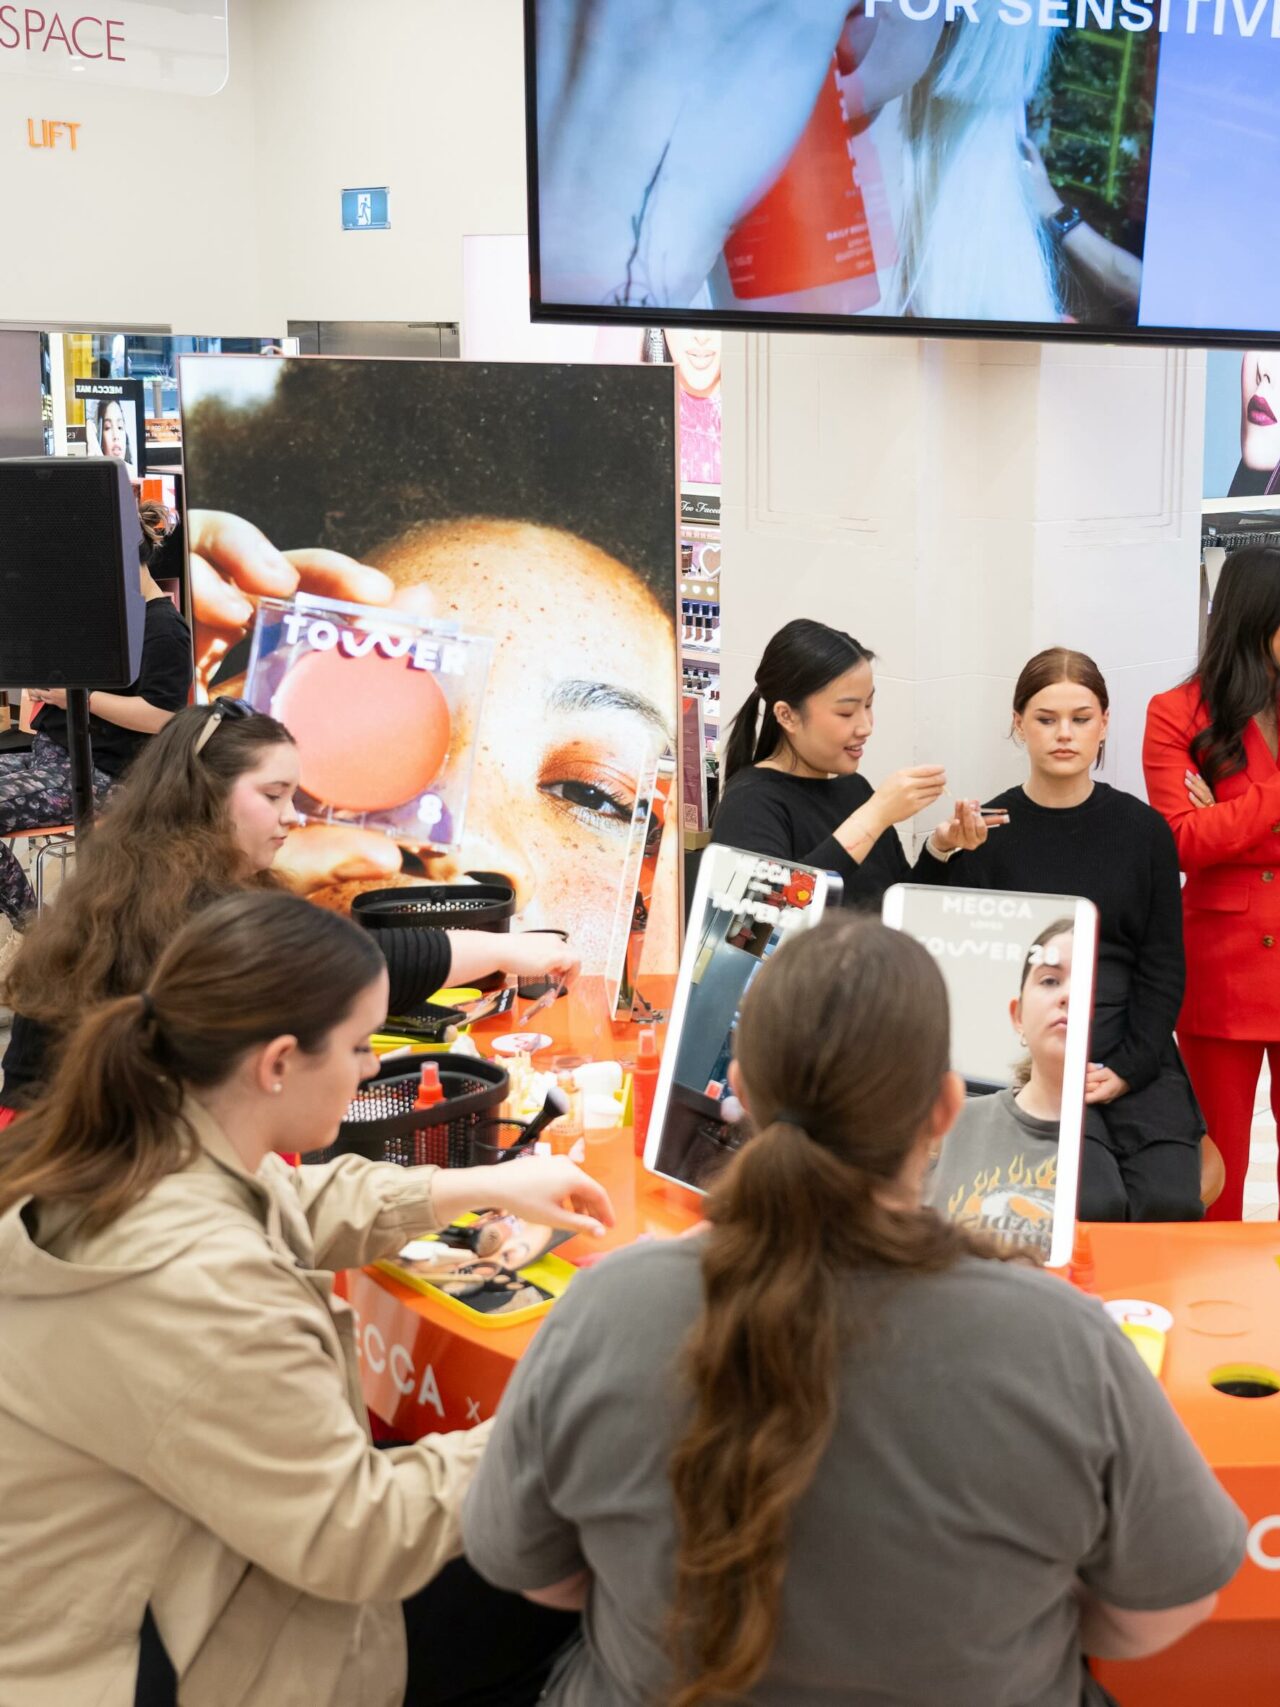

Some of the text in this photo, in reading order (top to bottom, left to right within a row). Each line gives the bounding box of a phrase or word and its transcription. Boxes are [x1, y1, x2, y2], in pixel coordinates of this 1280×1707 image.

[0, 5, 126, 62] SPACE
[27, 117, 81, 151] LIFT
[695, 502, 720, 514] Face
[283, 614, 467, 675] TOWER
[942, 895, 1033, 919] MECCA
[355, 1312, 446, 1418] CCA
